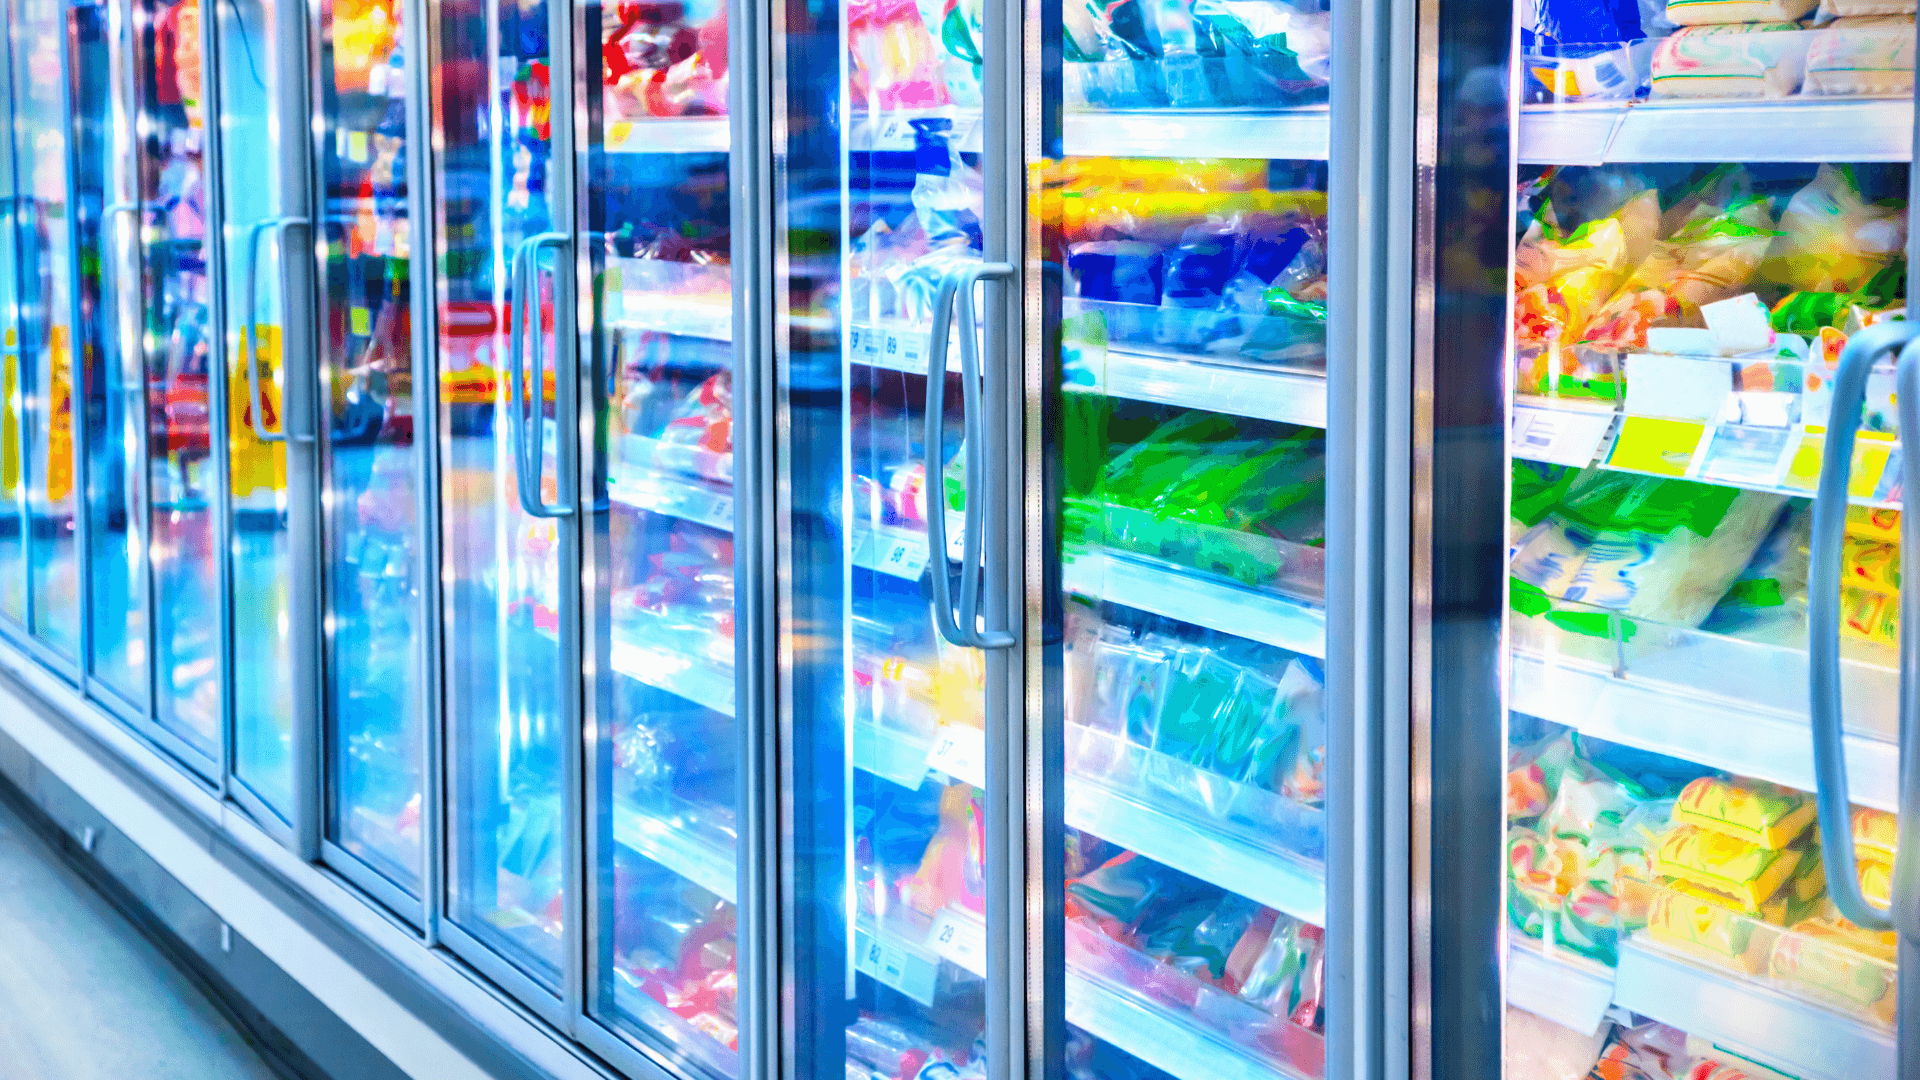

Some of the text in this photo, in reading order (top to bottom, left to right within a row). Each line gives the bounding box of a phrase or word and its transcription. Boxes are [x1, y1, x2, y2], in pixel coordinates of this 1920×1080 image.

[886, 336, 897, 355] 89
[937, 739, 954, 757] 37
[939, 924, 955, 944] 29
